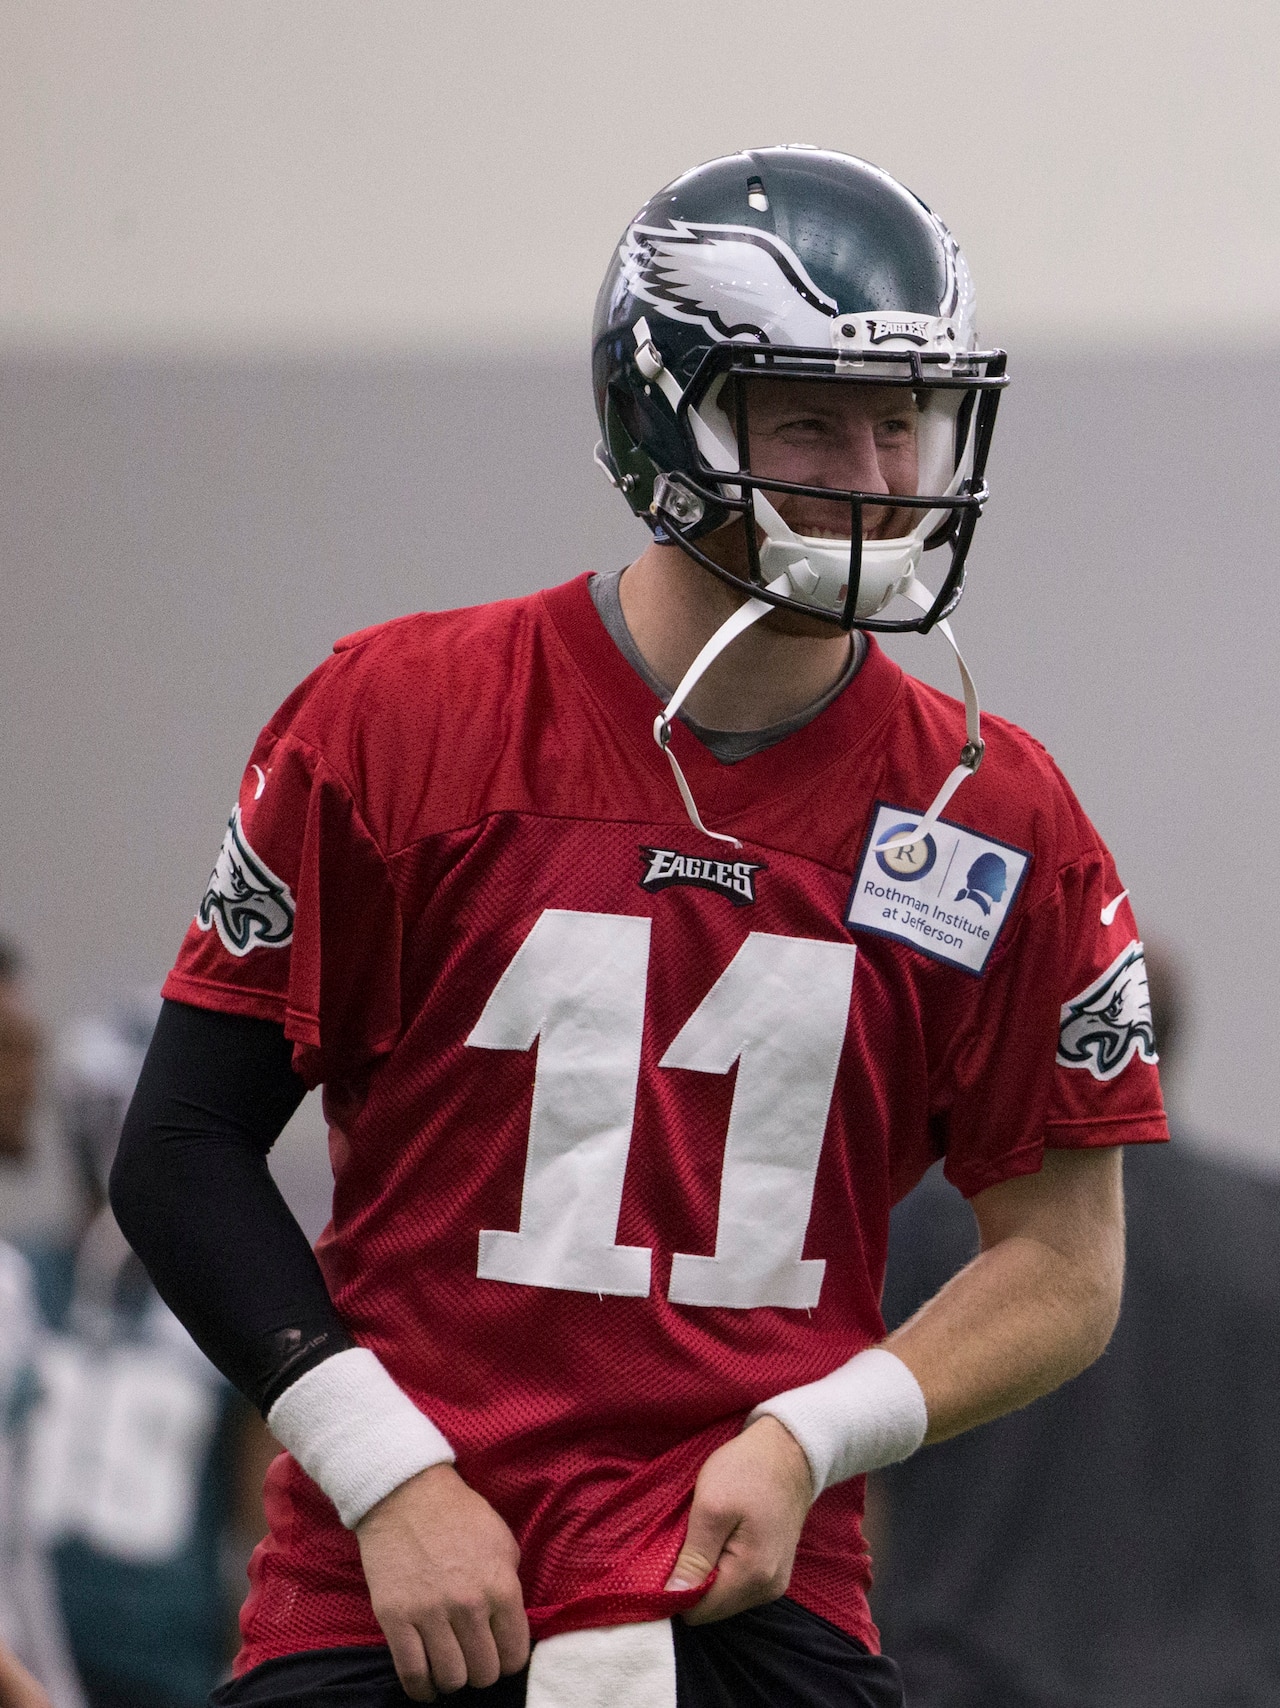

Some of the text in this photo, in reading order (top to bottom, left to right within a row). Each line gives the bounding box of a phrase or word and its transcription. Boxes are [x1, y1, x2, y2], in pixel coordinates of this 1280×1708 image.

[868, 320, 929, 343] EAGLES
[643, 848, 761, 901] EAGLES
[863, 881, 990, 941] Rothman Institute
[882, 907, 964, 949] at Jefferson
[464, 908, 857, 1310] 11
